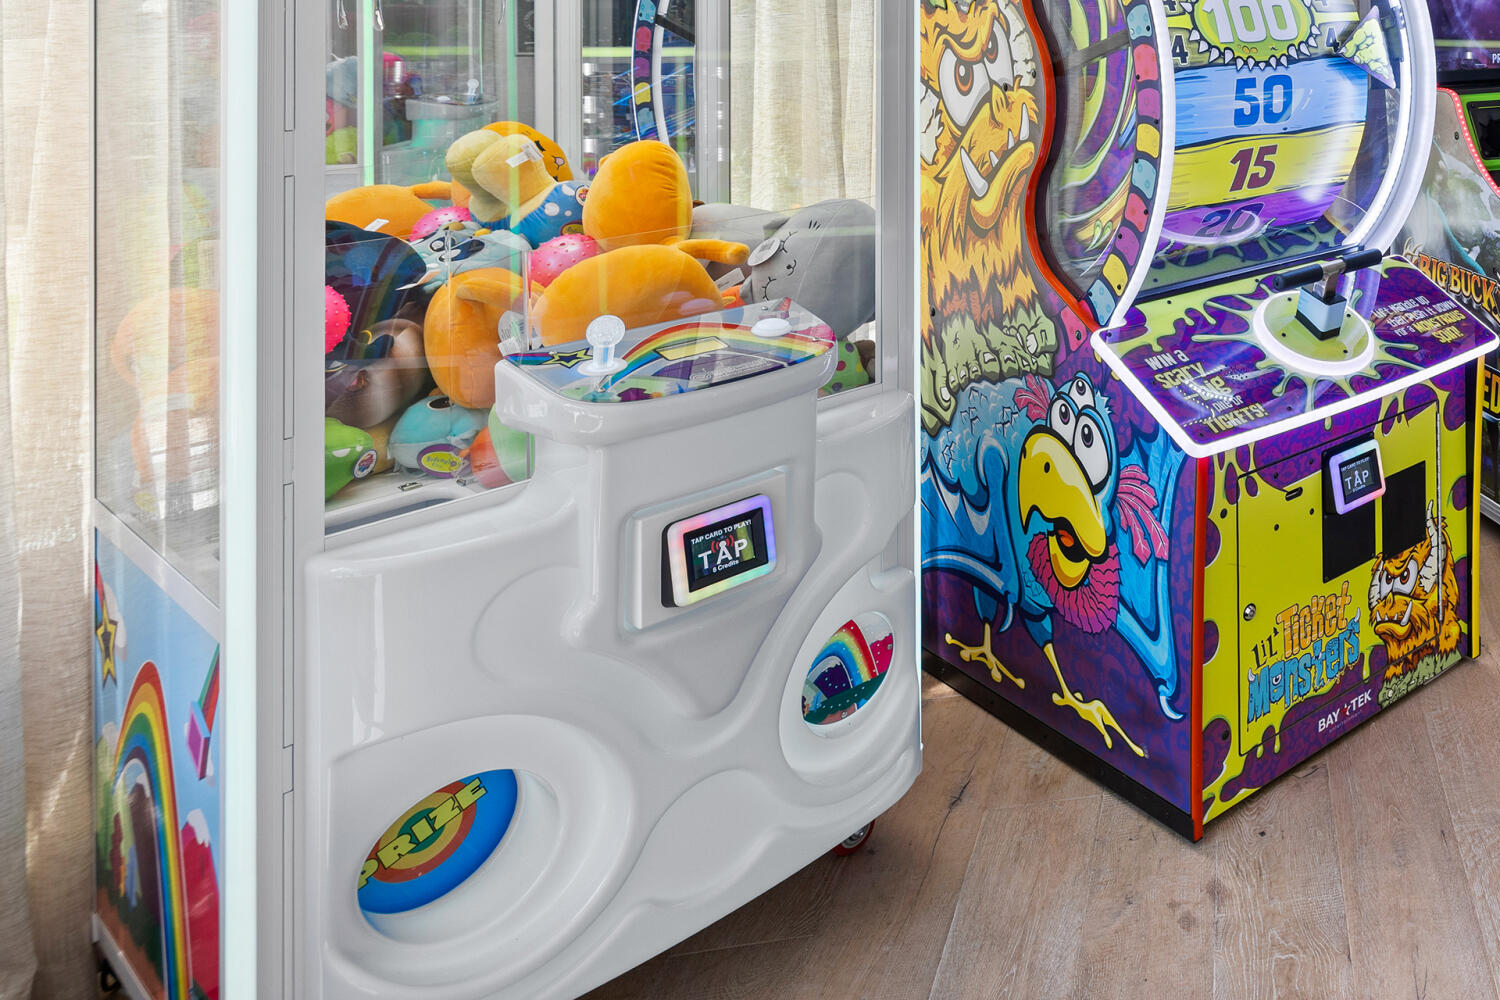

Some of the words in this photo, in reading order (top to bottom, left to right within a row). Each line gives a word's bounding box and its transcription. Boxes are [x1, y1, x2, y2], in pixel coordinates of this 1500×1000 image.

[1232, 73, 1293, 129] 50
[1229, 144, 1279, 192] 15
[1418, 253, 1448, 289] BIG
[1449, 264, 1500, 327] BUCK
[1411, 309, 1467, 334] MONSTROUS
[1144, 352, 1178, 371] WIN
[1173, 349, 1190, 363] a
[1202, 402, 1269, 434] TICKETS!
[1345, 470, 1369, 489] TAP
[691, 536, 704, 545] TAP
[705, 530, 722, 540] CARD
[734, 519, 752, 530] PLAY!
[698, 538, 748, 569] TAP
[1318, 709, 1340, 732] BAY
[1350, 689, 1372, 711] TEK
[357, 777, 488, 891] PRIZE
